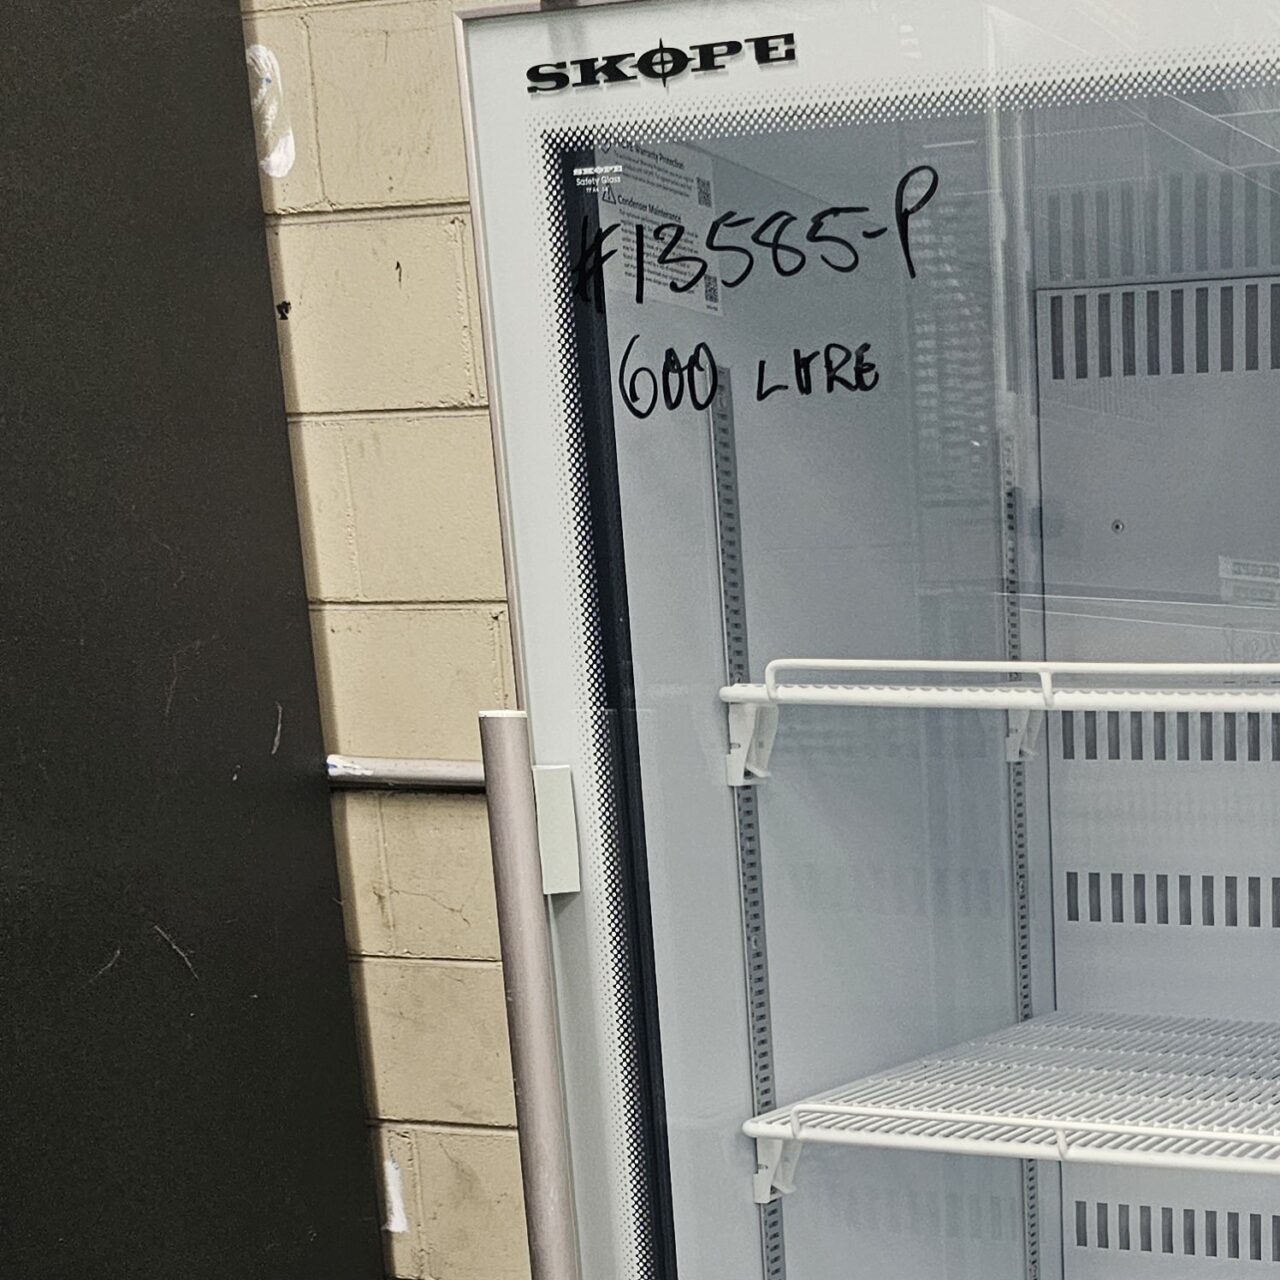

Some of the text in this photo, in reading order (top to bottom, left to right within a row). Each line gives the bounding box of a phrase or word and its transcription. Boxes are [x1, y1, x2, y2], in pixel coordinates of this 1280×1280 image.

[526, 33, 796, 94] SKOPE
[576, 175, 621, 187] Safety Glass
[617, 194, 682, 222] Condenser Maintenance
[619, 334, 718, 419] 600
